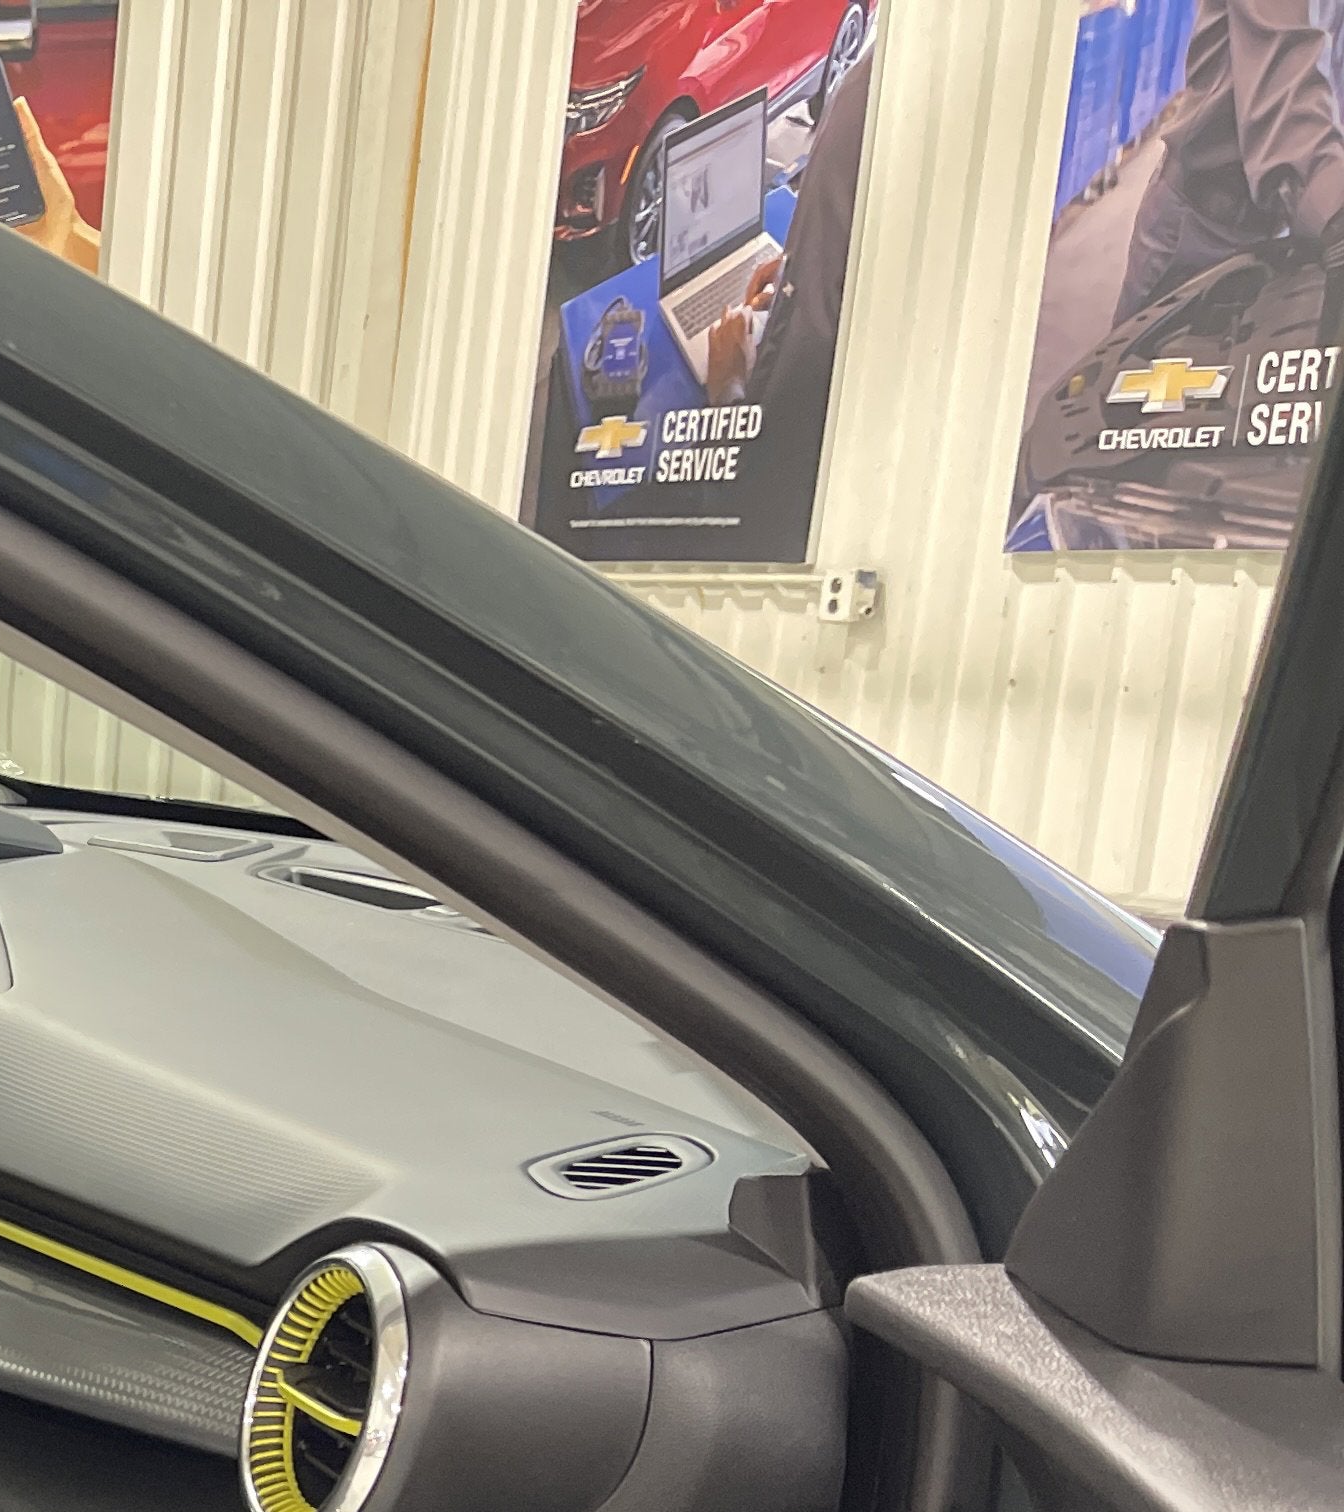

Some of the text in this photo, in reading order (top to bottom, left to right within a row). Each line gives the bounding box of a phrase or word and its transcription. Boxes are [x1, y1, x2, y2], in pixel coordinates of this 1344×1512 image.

[662, 405, 763, 443] CERTIFIED
[1098, 425, 1226, 450] CHEVROLET
[570, 466, 647, 489] CHEVROLET
[656, 446, 741, 483] SERVICE
